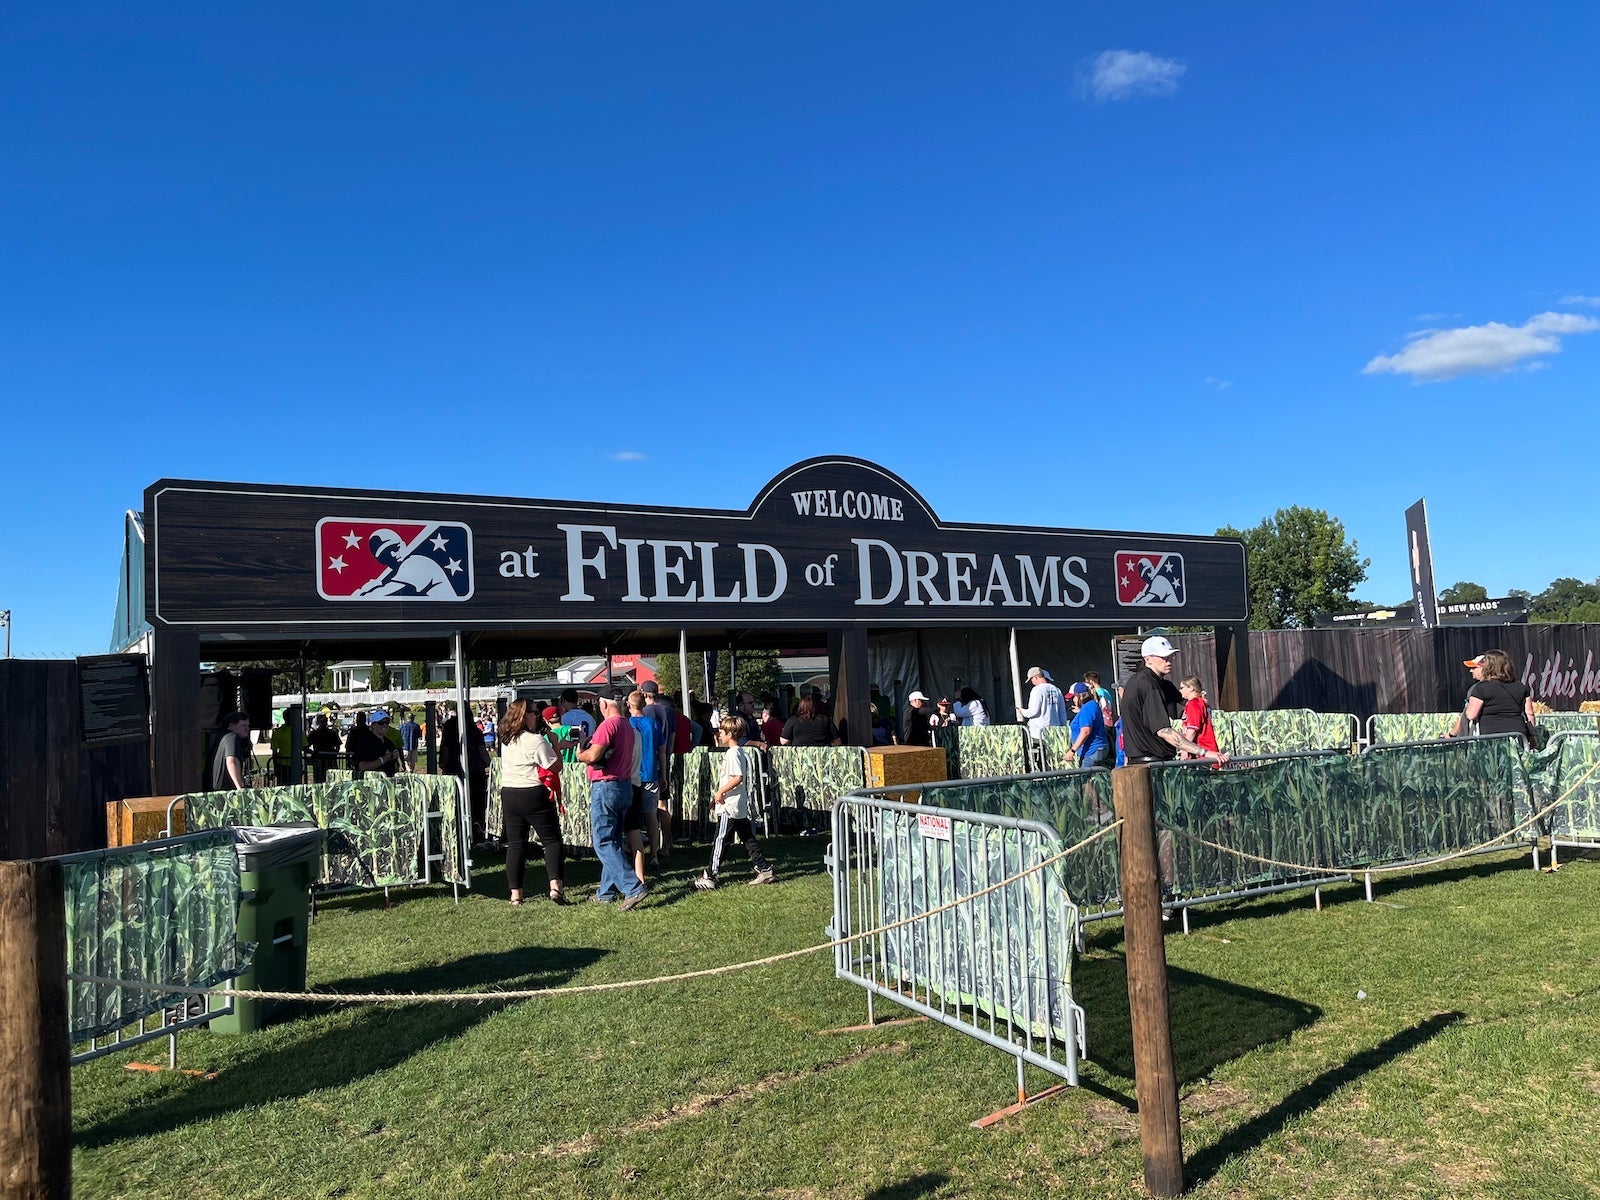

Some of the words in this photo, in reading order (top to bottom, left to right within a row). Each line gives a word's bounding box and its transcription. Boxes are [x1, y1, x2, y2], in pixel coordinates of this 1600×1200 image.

[790, 489, 905, 521] WELCOME
[499, 545, 540, 578] at
[556, 523, 788, 603] FIELD
[804, 553, 838, 587] of
[851, 537, 1092, 608] DREAMS
[1448, 604, 1467, 613] NEW
[1539, 650, 1579, 698] this
[919, 815, 949, 829] NATIONAL
